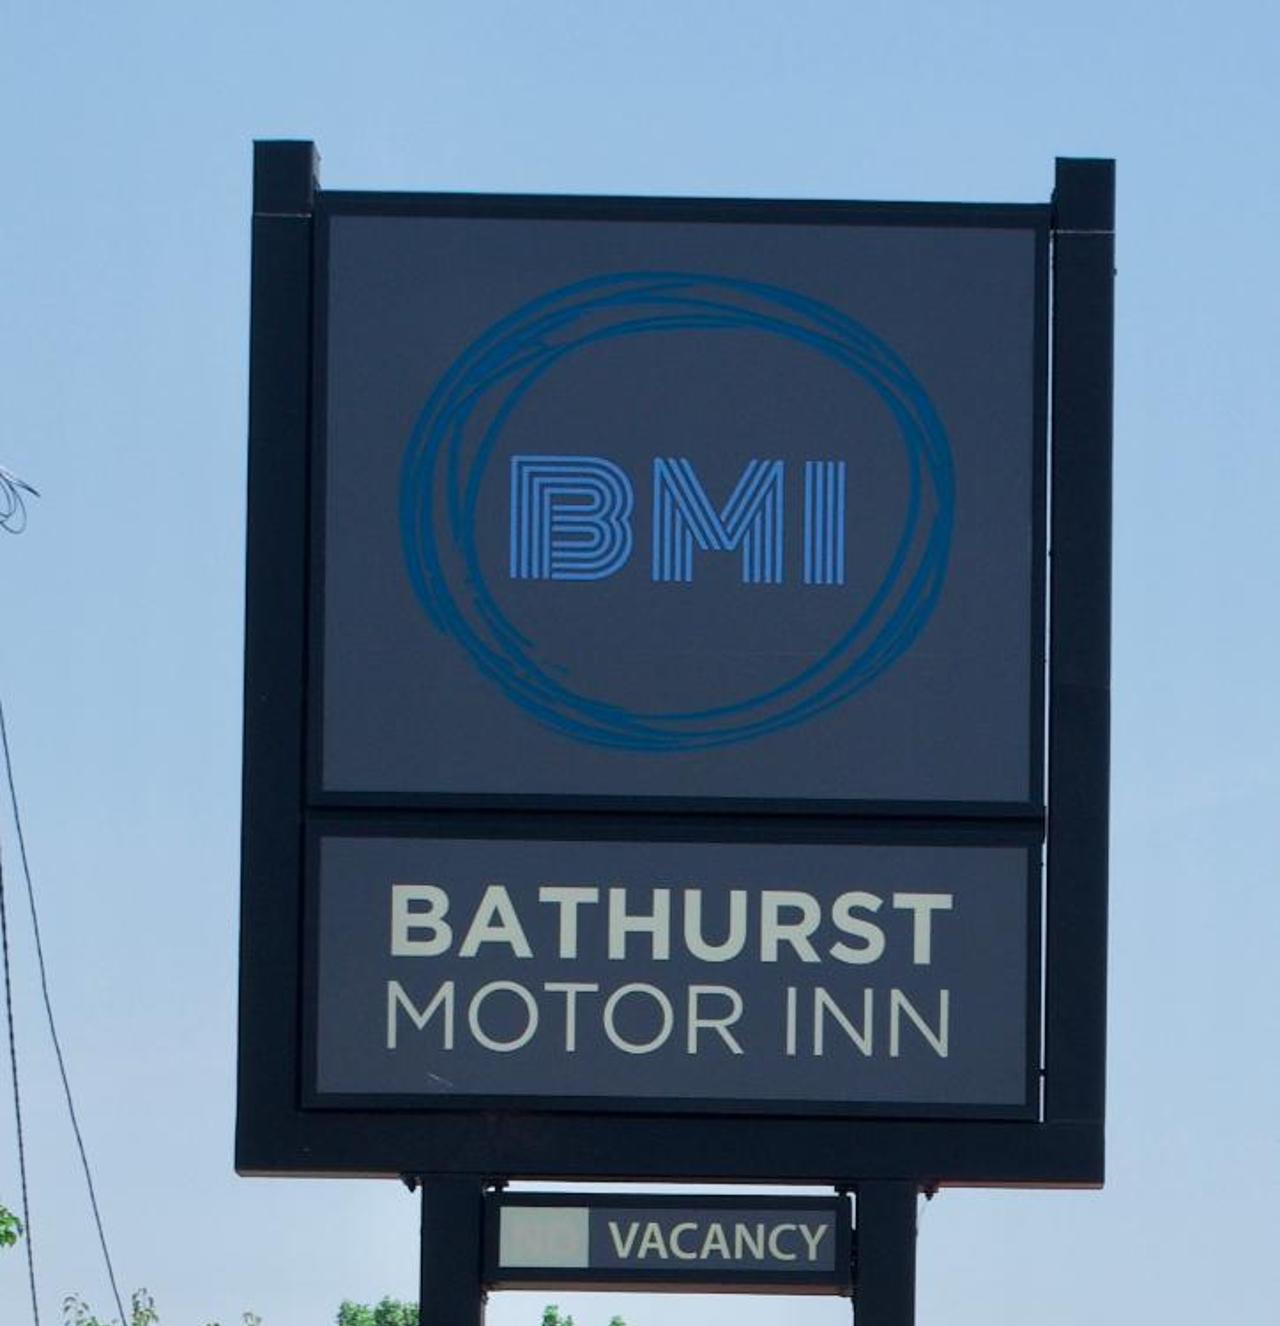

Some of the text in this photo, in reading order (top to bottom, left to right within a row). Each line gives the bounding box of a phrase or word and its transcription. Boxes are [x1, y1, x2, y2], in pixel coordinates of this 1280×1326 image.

[510, 455, 846, 585] BMI
[391, 884, 953, 965] BATHURST
[387, 980, 949, 1058] MOTOR INN
[608, 1221, 828, 1261] VACANCY
